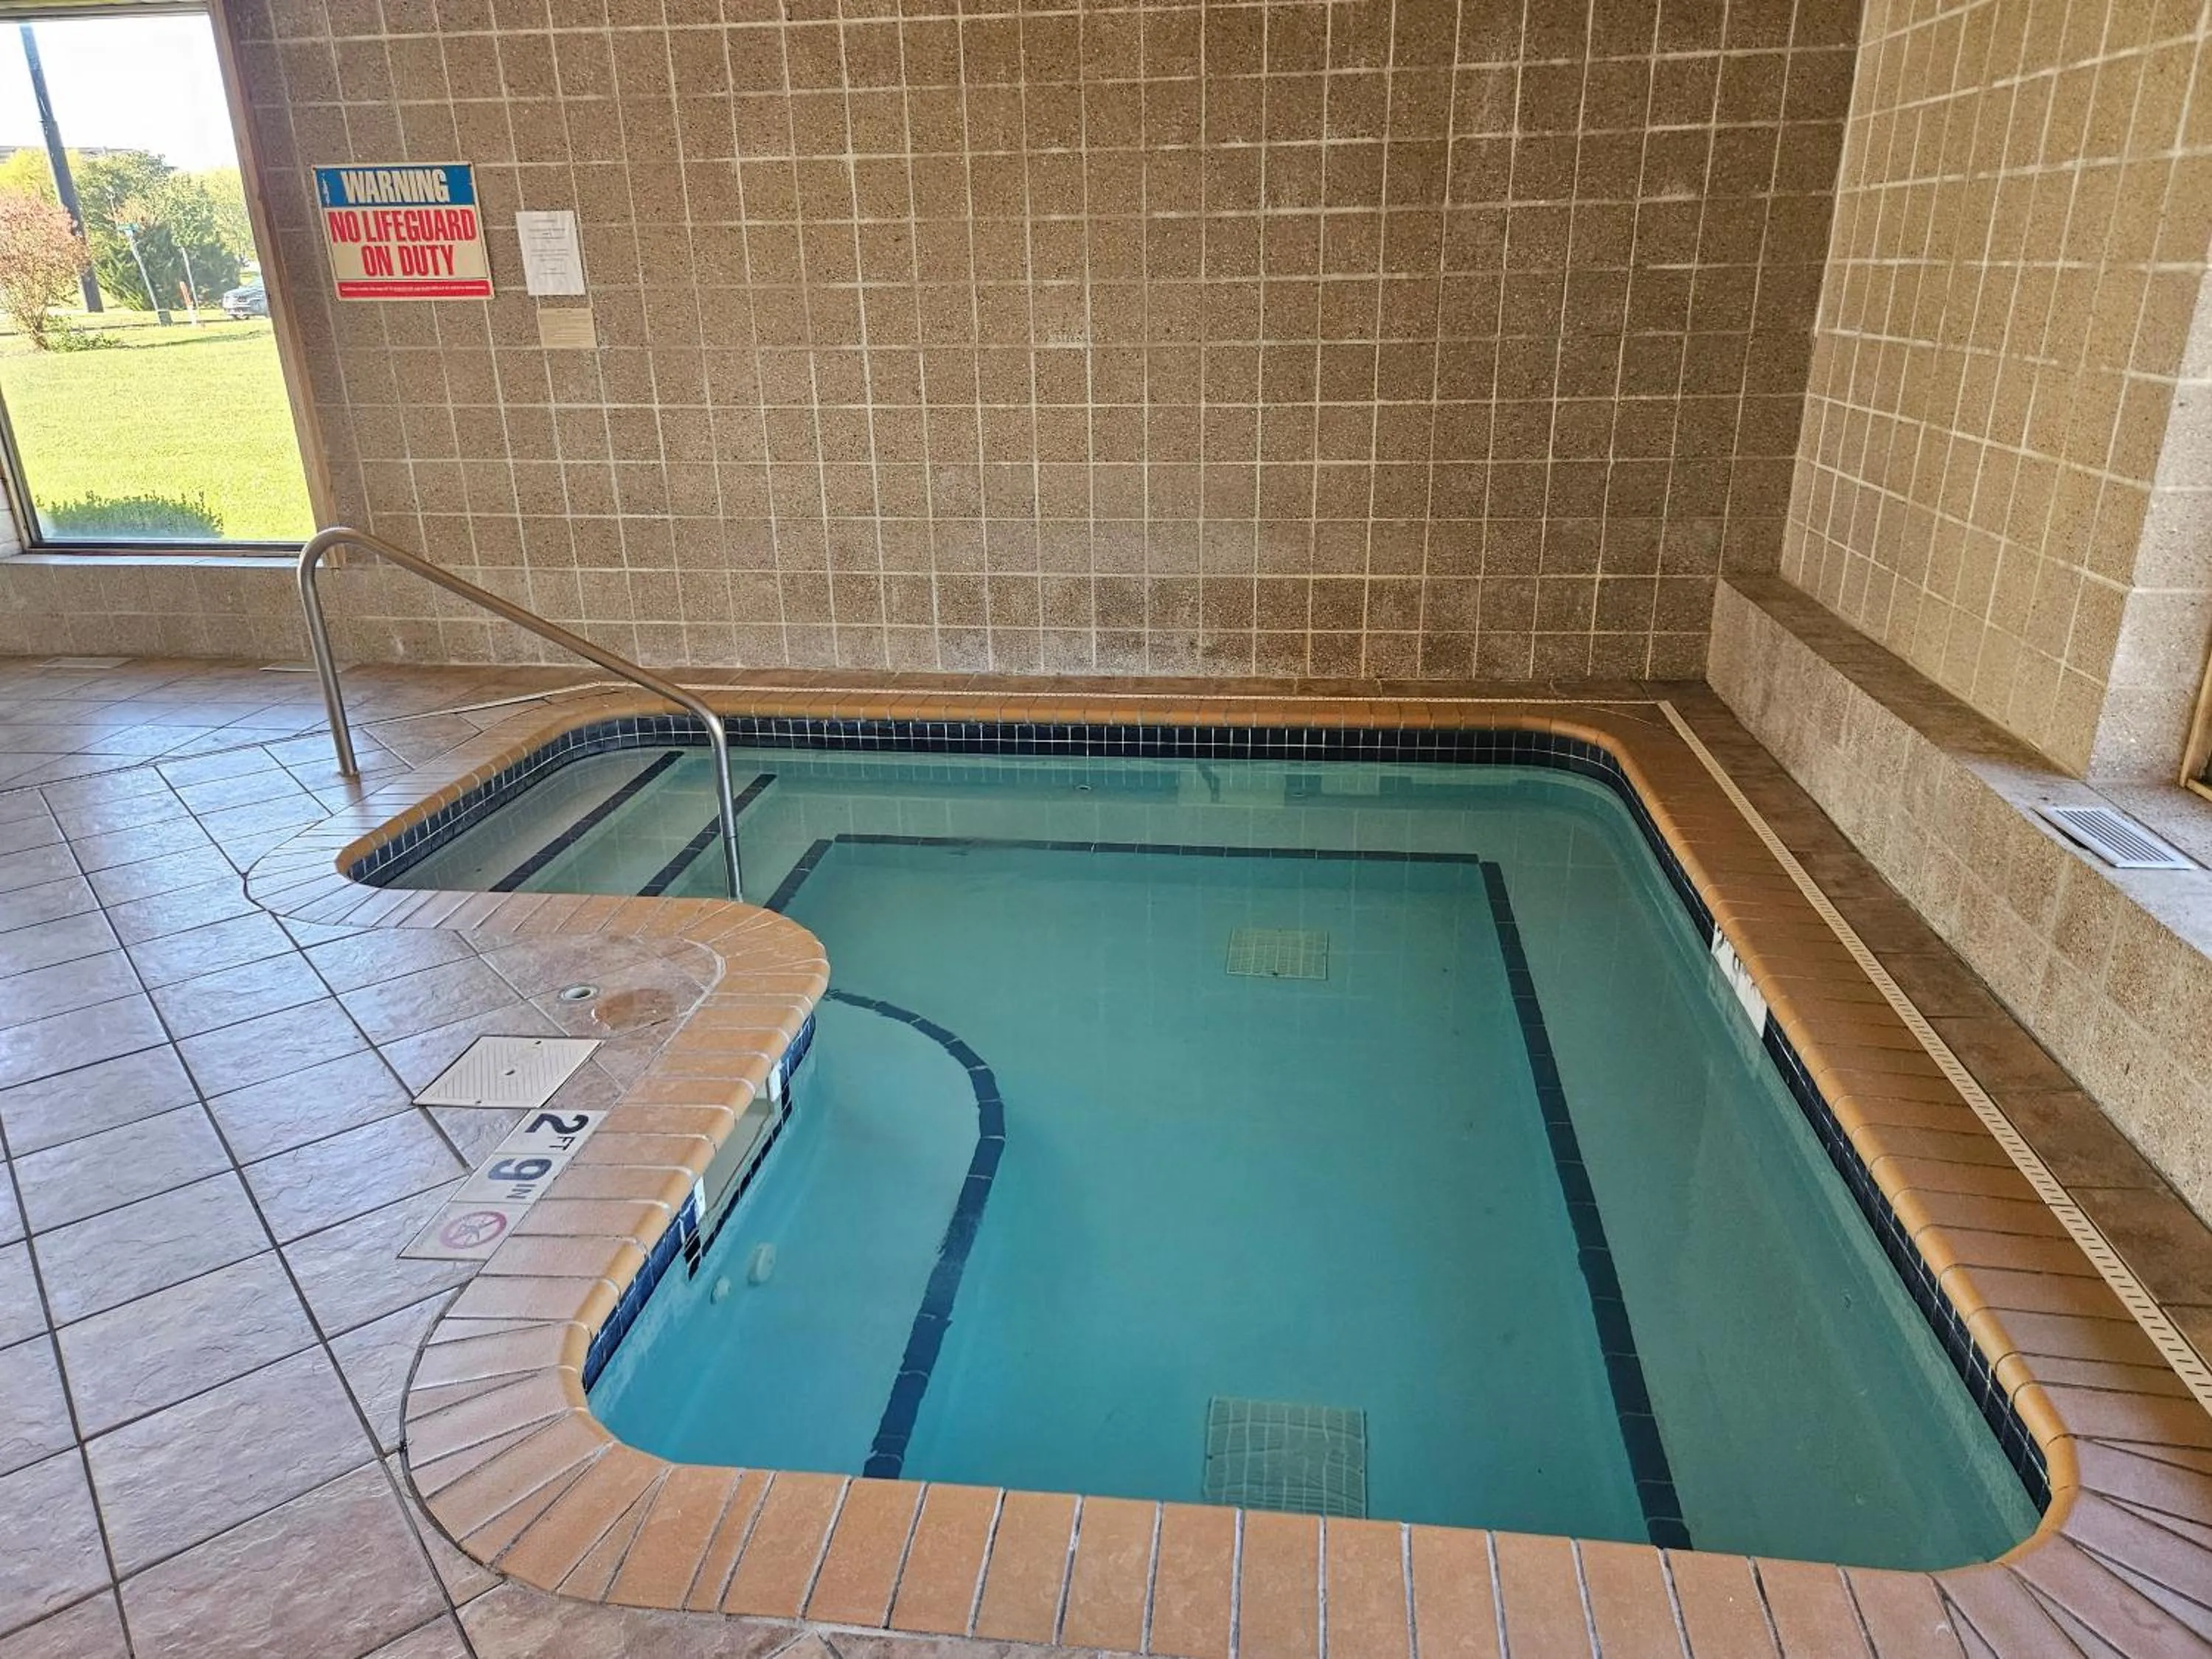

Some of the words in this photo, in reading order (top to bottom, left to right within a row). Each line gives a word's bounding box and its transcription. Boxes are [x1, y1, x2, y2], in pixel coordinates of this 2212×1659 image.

[340, 169, 450, 204] WARNING
[327, 211, 361, 243] NO
[362, 209, 477, 242] LIFEGUARD
[361, 246, 394, 276] ON
[398, 245, 454, 276] DUTY
[524, 1113, 589, 1134] 2
[549, 1136, 575, 1150] FT
[506, 1184, 538, 1199] IN
